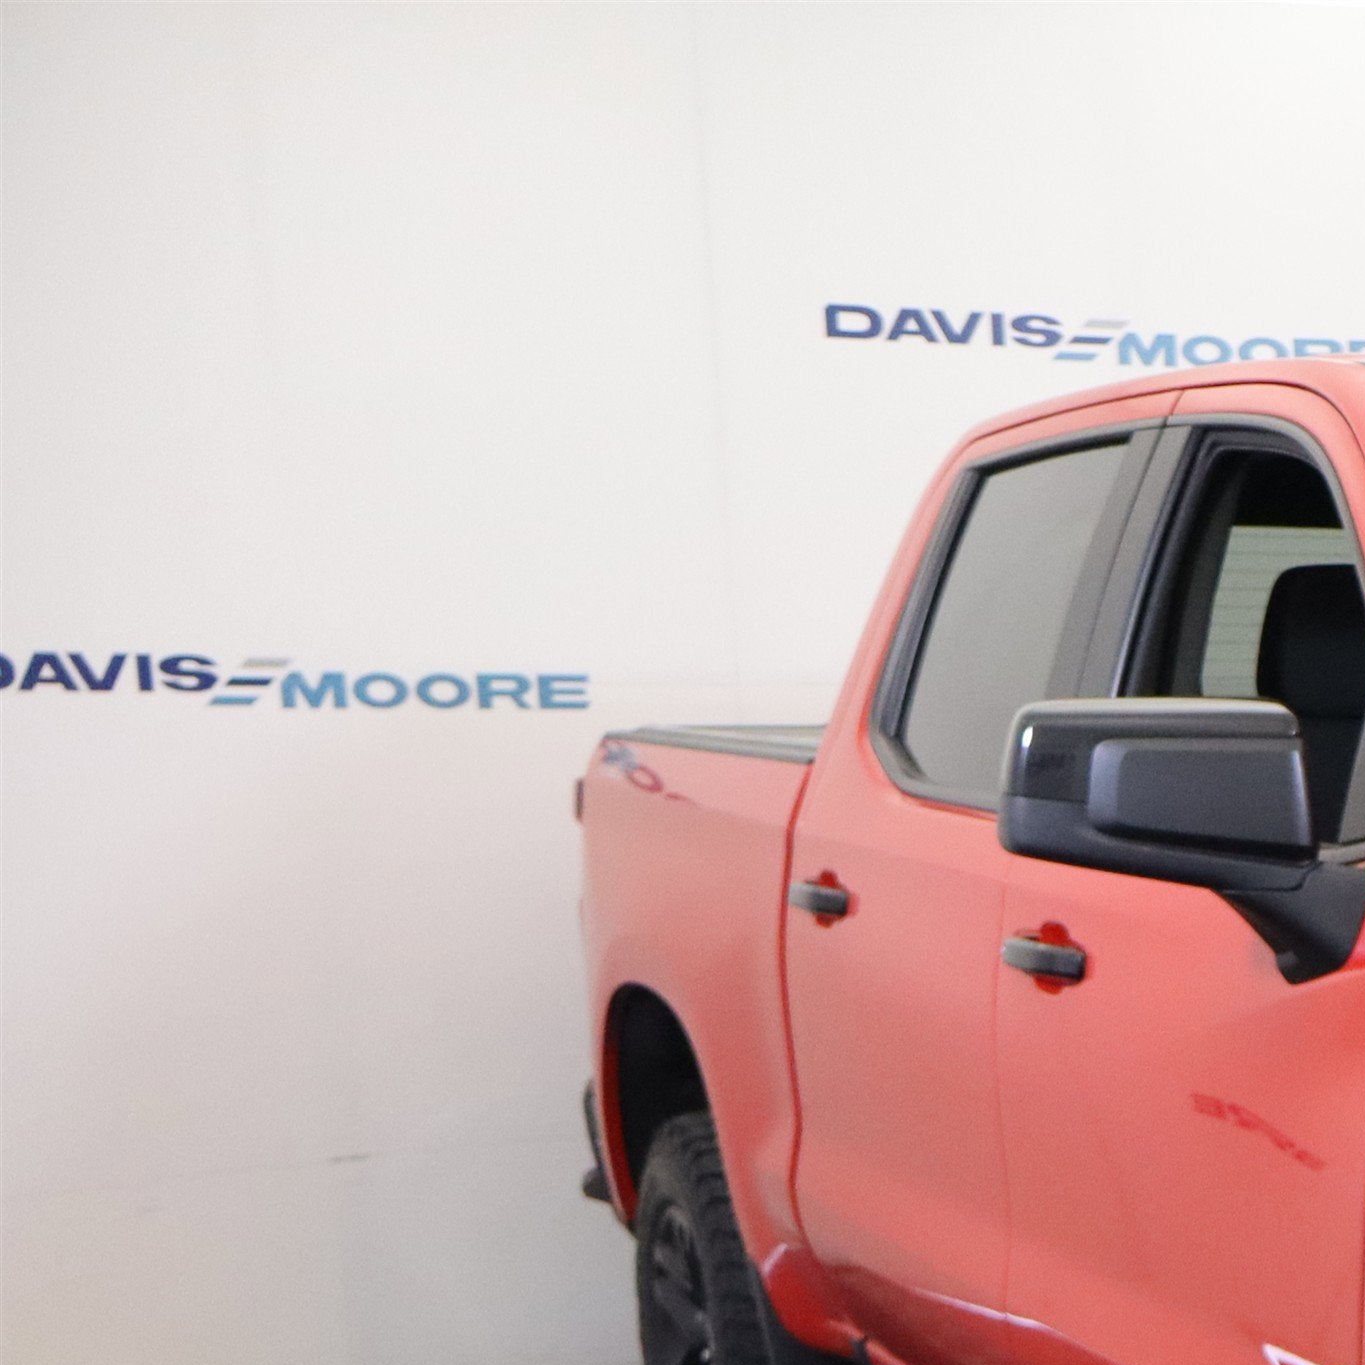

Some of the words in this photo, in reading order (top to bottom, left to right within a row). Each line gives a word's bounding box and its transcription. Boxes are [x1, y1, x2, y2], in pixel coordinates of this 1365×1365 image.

[824, 302, 1063, 347] DAVIS
[0, 652, 217, 693] AVIS
[280, 671, 590, 710] MOORE
